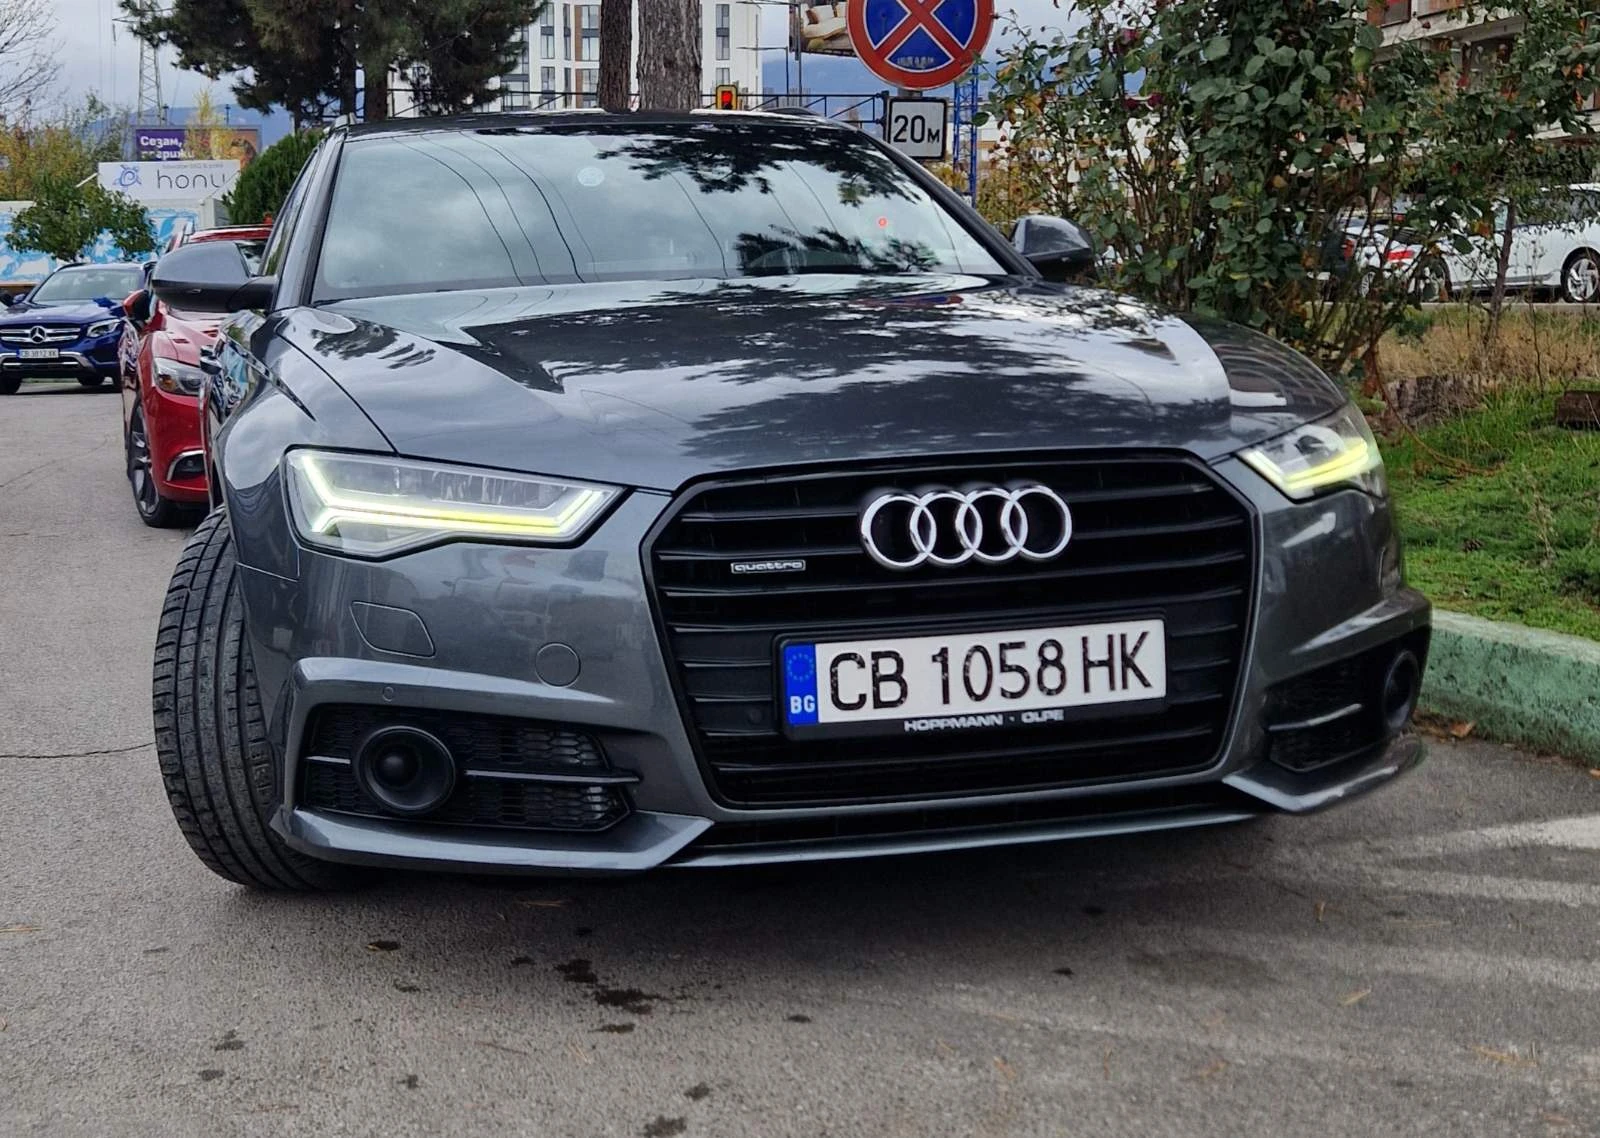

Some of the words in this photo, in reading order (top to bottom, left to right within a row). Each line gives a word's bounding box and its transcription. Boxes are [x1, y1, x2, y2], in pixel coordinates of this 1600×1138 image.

[140, 136, 182, 148] Сезам,
[157, 168, 225, 189] honu
[734, 561, 804, 573] quattro
[829, 649, 908, 712] CB
[931, 637, 1065, 706] 1058
[1082, 630, 1153, 695] HK
[789, 694, 816, 715] BG
[904, 713, 1003, 732] HOPPMANN
